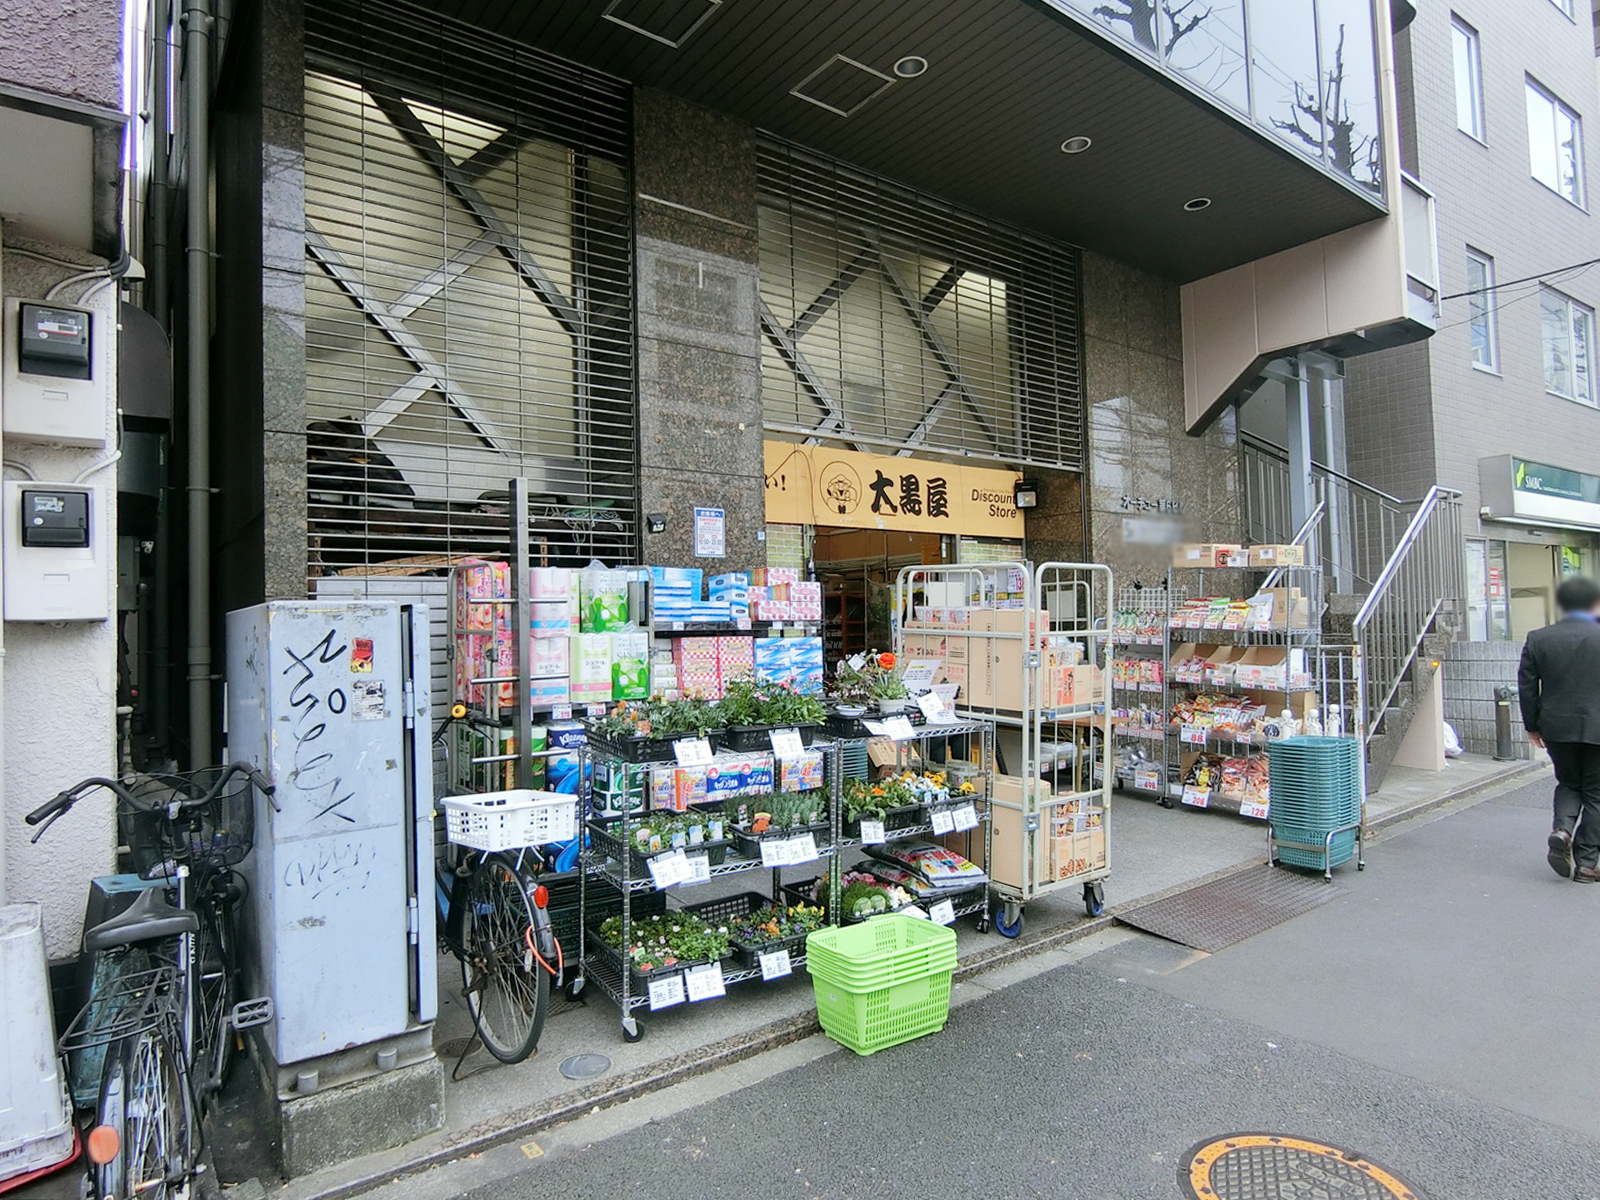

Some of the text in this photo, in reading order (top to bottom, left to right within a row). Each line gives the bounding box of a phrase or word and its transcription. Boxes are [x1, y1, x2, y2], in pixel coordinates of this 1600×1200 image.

[1525, 475, 1543, 490] SMBC
[869, 469, 949, 518] 大黒屋
[971, 488, 1016, 504] Discount
[988, 504, 1017, 518] Store
[1191, 734, 1203, 743] 88
[1251, 807, 1265, 817] 128
